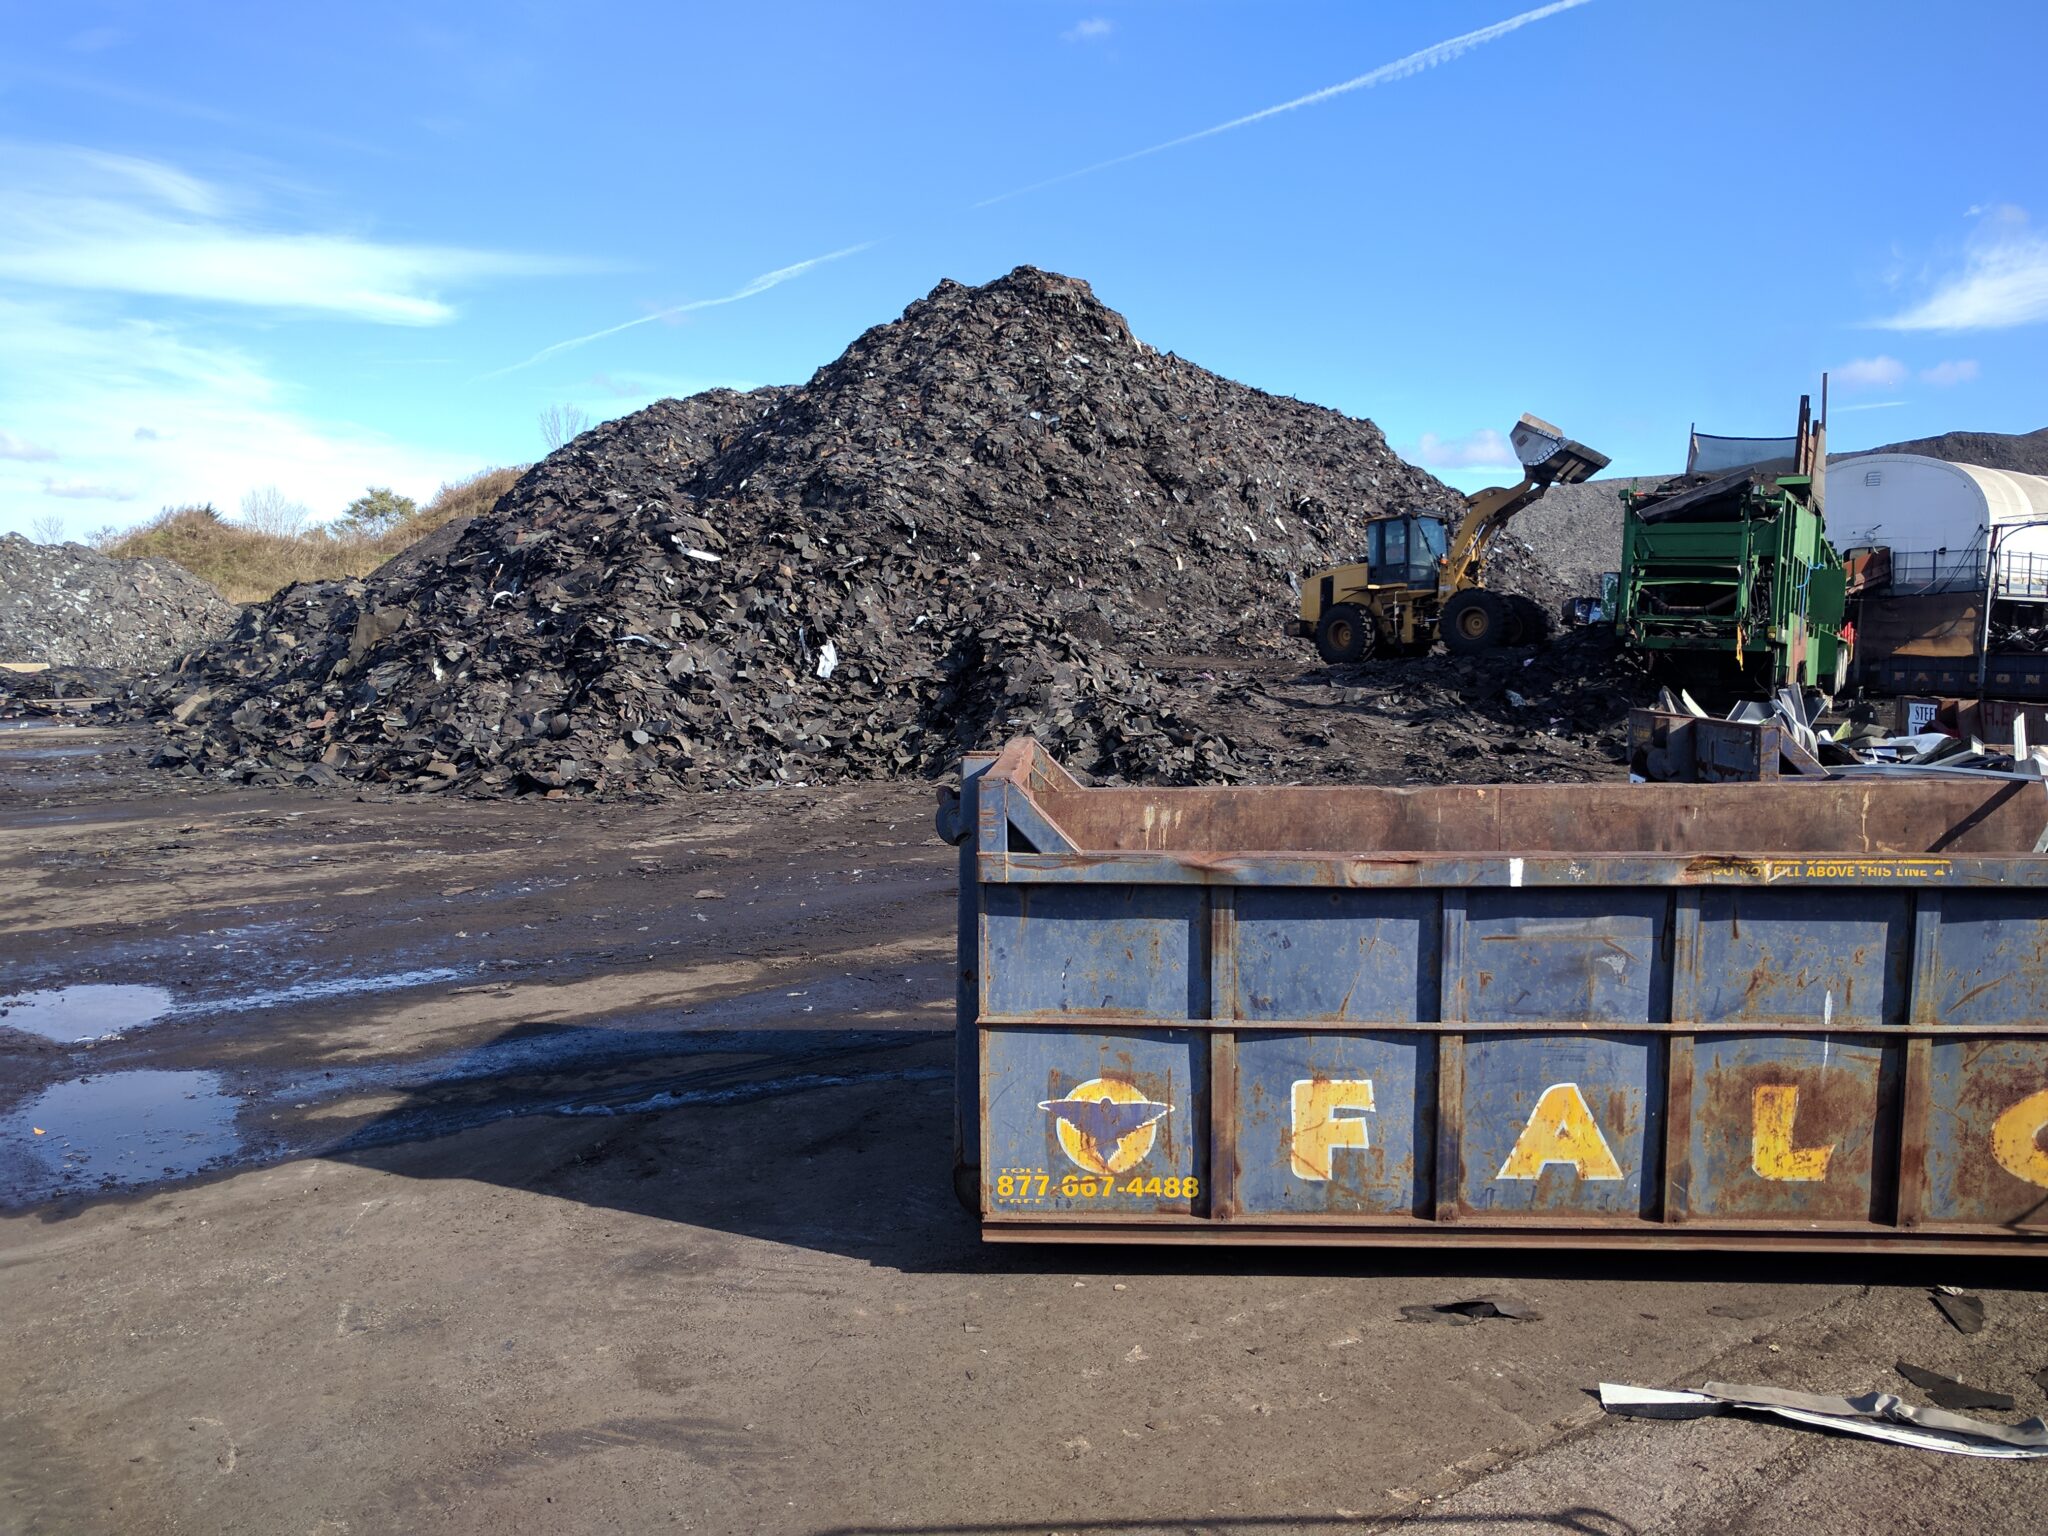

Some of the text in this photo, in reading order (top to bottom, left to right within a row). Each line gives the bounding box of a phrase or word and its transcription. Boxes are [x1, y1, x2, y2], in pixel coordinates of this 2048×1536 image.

[1894, 672, 2040, 684] FALCON
[1806, 866, 1855, 877] ABOVE
[1859, 866, 1892, 877] THIS
[1896, 867, 1928, 877] LINE
[997, 1175, 1199, 1198] 877-667-4488
